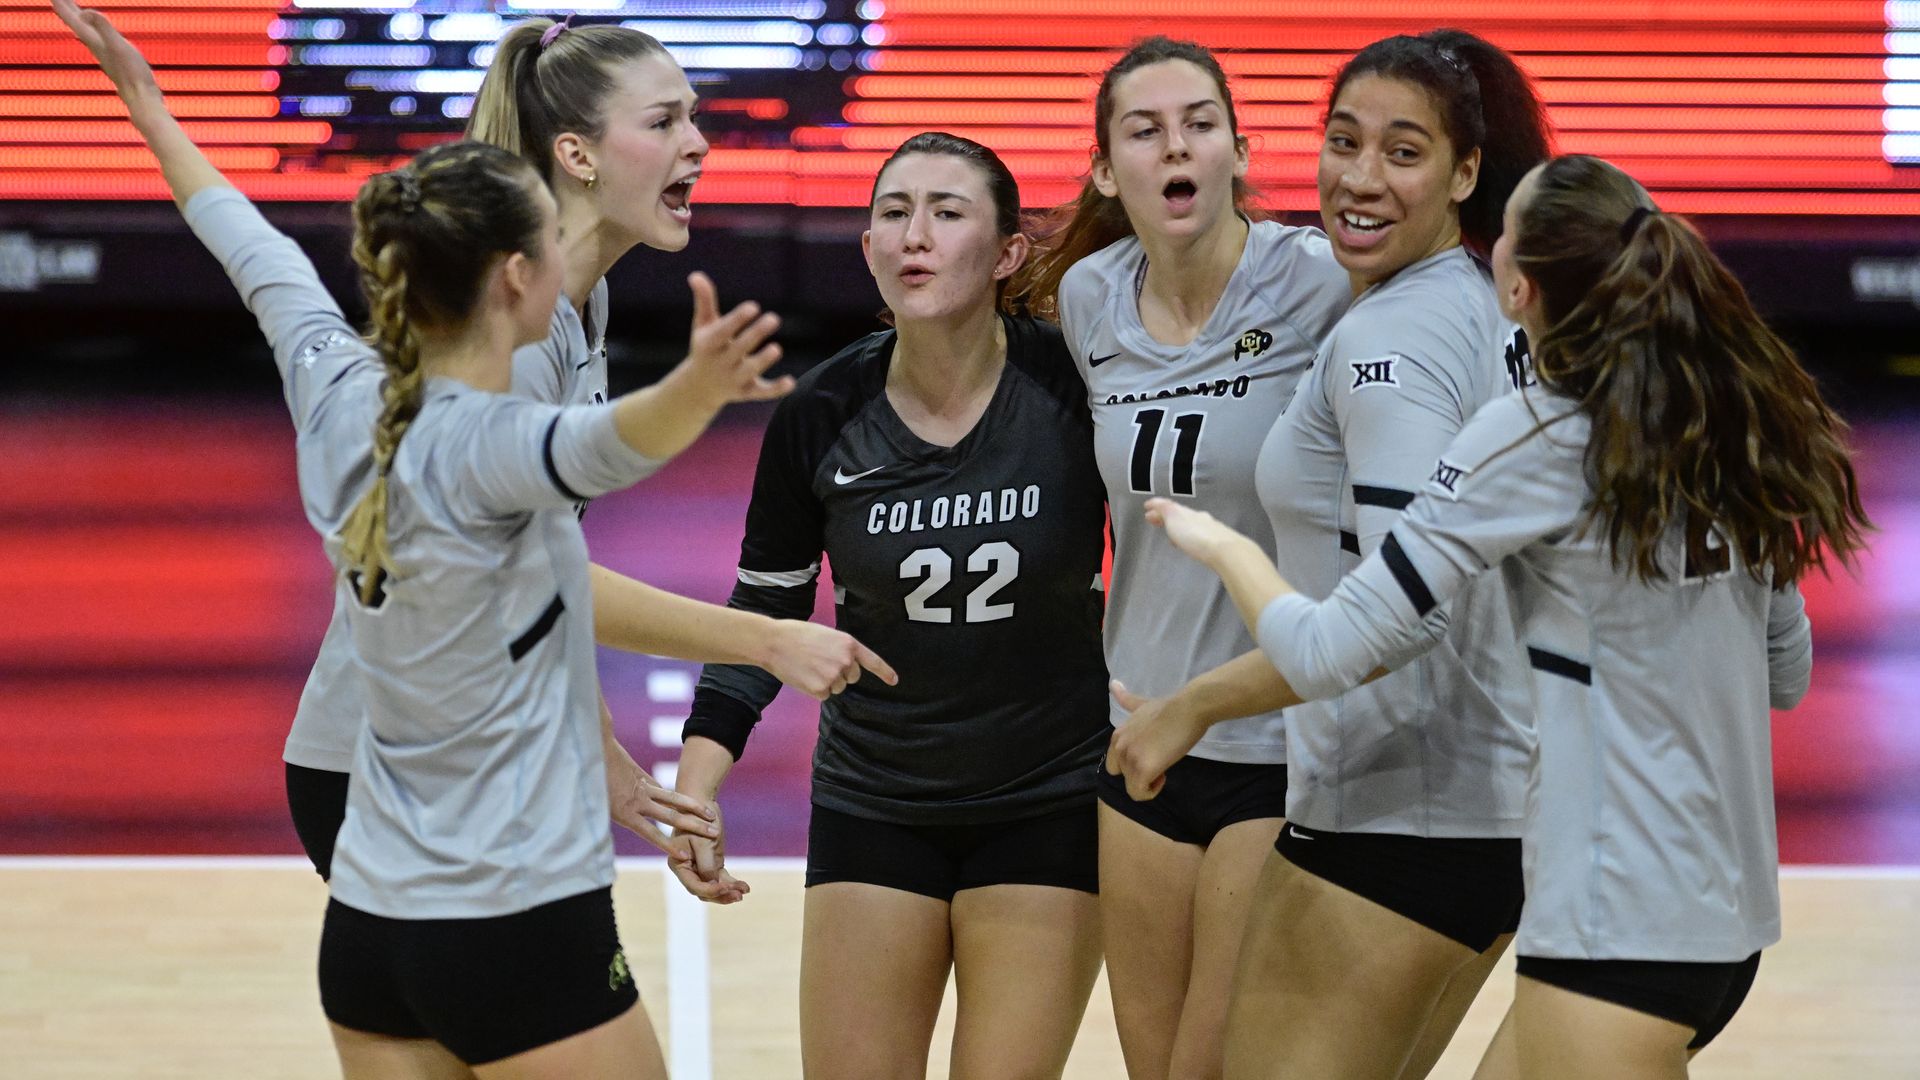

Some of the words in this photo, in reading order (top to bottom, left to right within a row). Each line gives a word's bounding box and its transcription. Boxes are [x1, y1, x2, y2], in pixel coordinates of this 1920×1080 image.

[1351, 358, 1398, 389] XII
[1129, 407, 1206, 496] 11
[866, 484, 1041, 535] COLORADO
[900, 541, 1019, 623] 22
